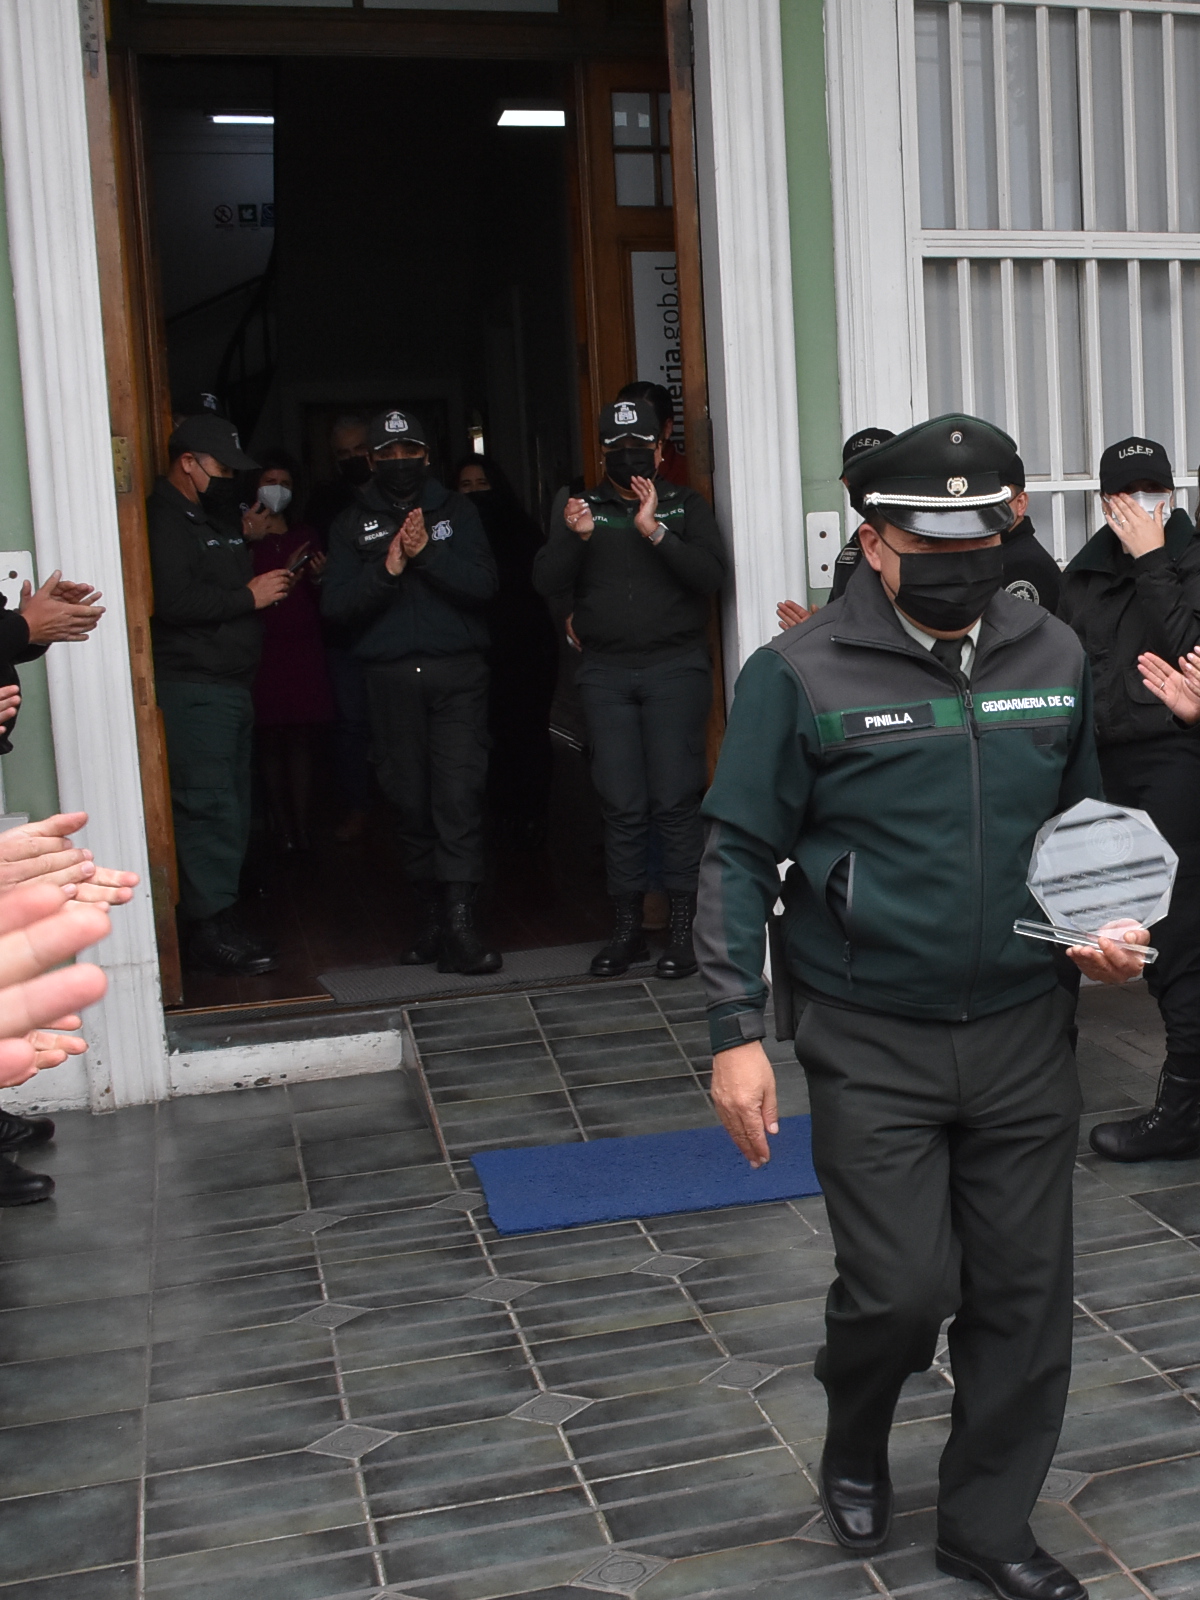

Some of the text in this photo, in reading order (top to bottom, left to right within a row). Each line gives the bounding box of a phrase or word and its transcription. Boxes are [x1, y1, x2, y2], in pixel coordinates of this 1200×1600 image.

[981, 697, 1047, 713] GENDARMERIA
[1047, 696, 1062, 707] DE
[864, 712, 913, 729] PINILLA
